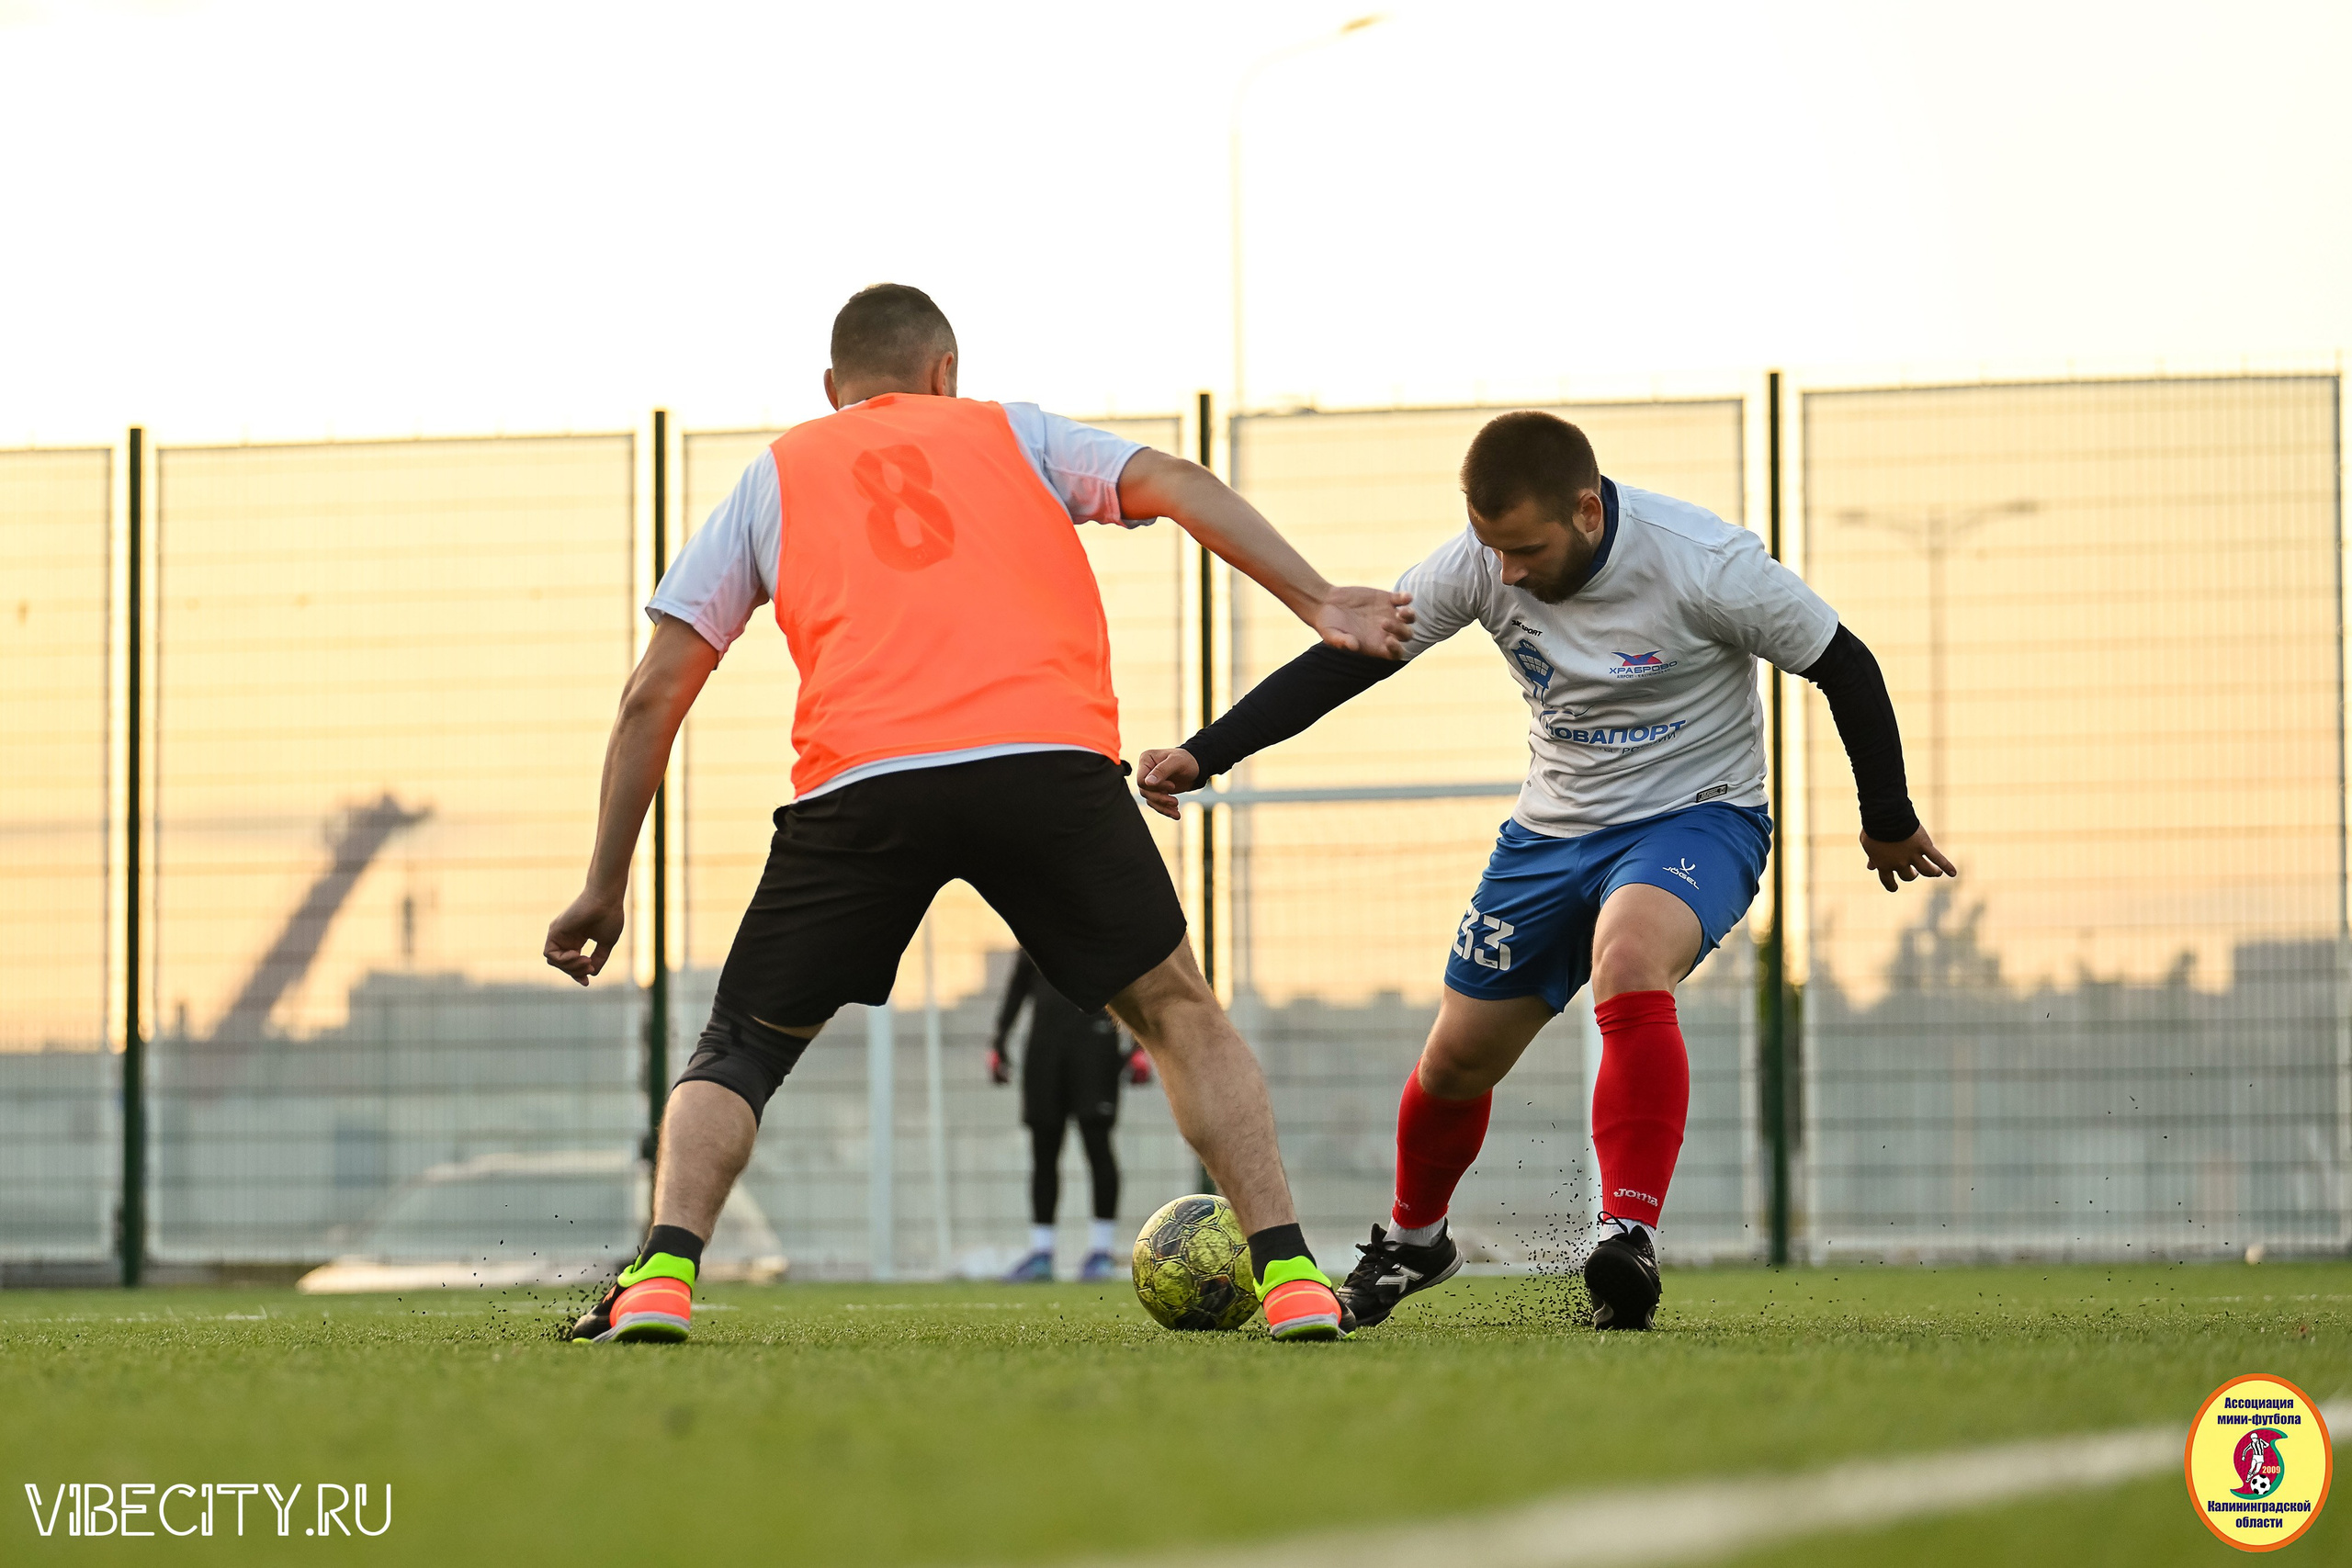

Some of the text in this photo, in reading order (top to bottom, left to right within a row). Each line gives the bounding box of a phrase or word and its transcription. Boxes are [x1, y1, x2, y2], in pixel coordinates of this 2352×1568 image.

[852, 444, 956, 573] 8
[1609, 660, 1678, 674] ХРАБРОВО
[1453, 903, 1515, 971] 33
